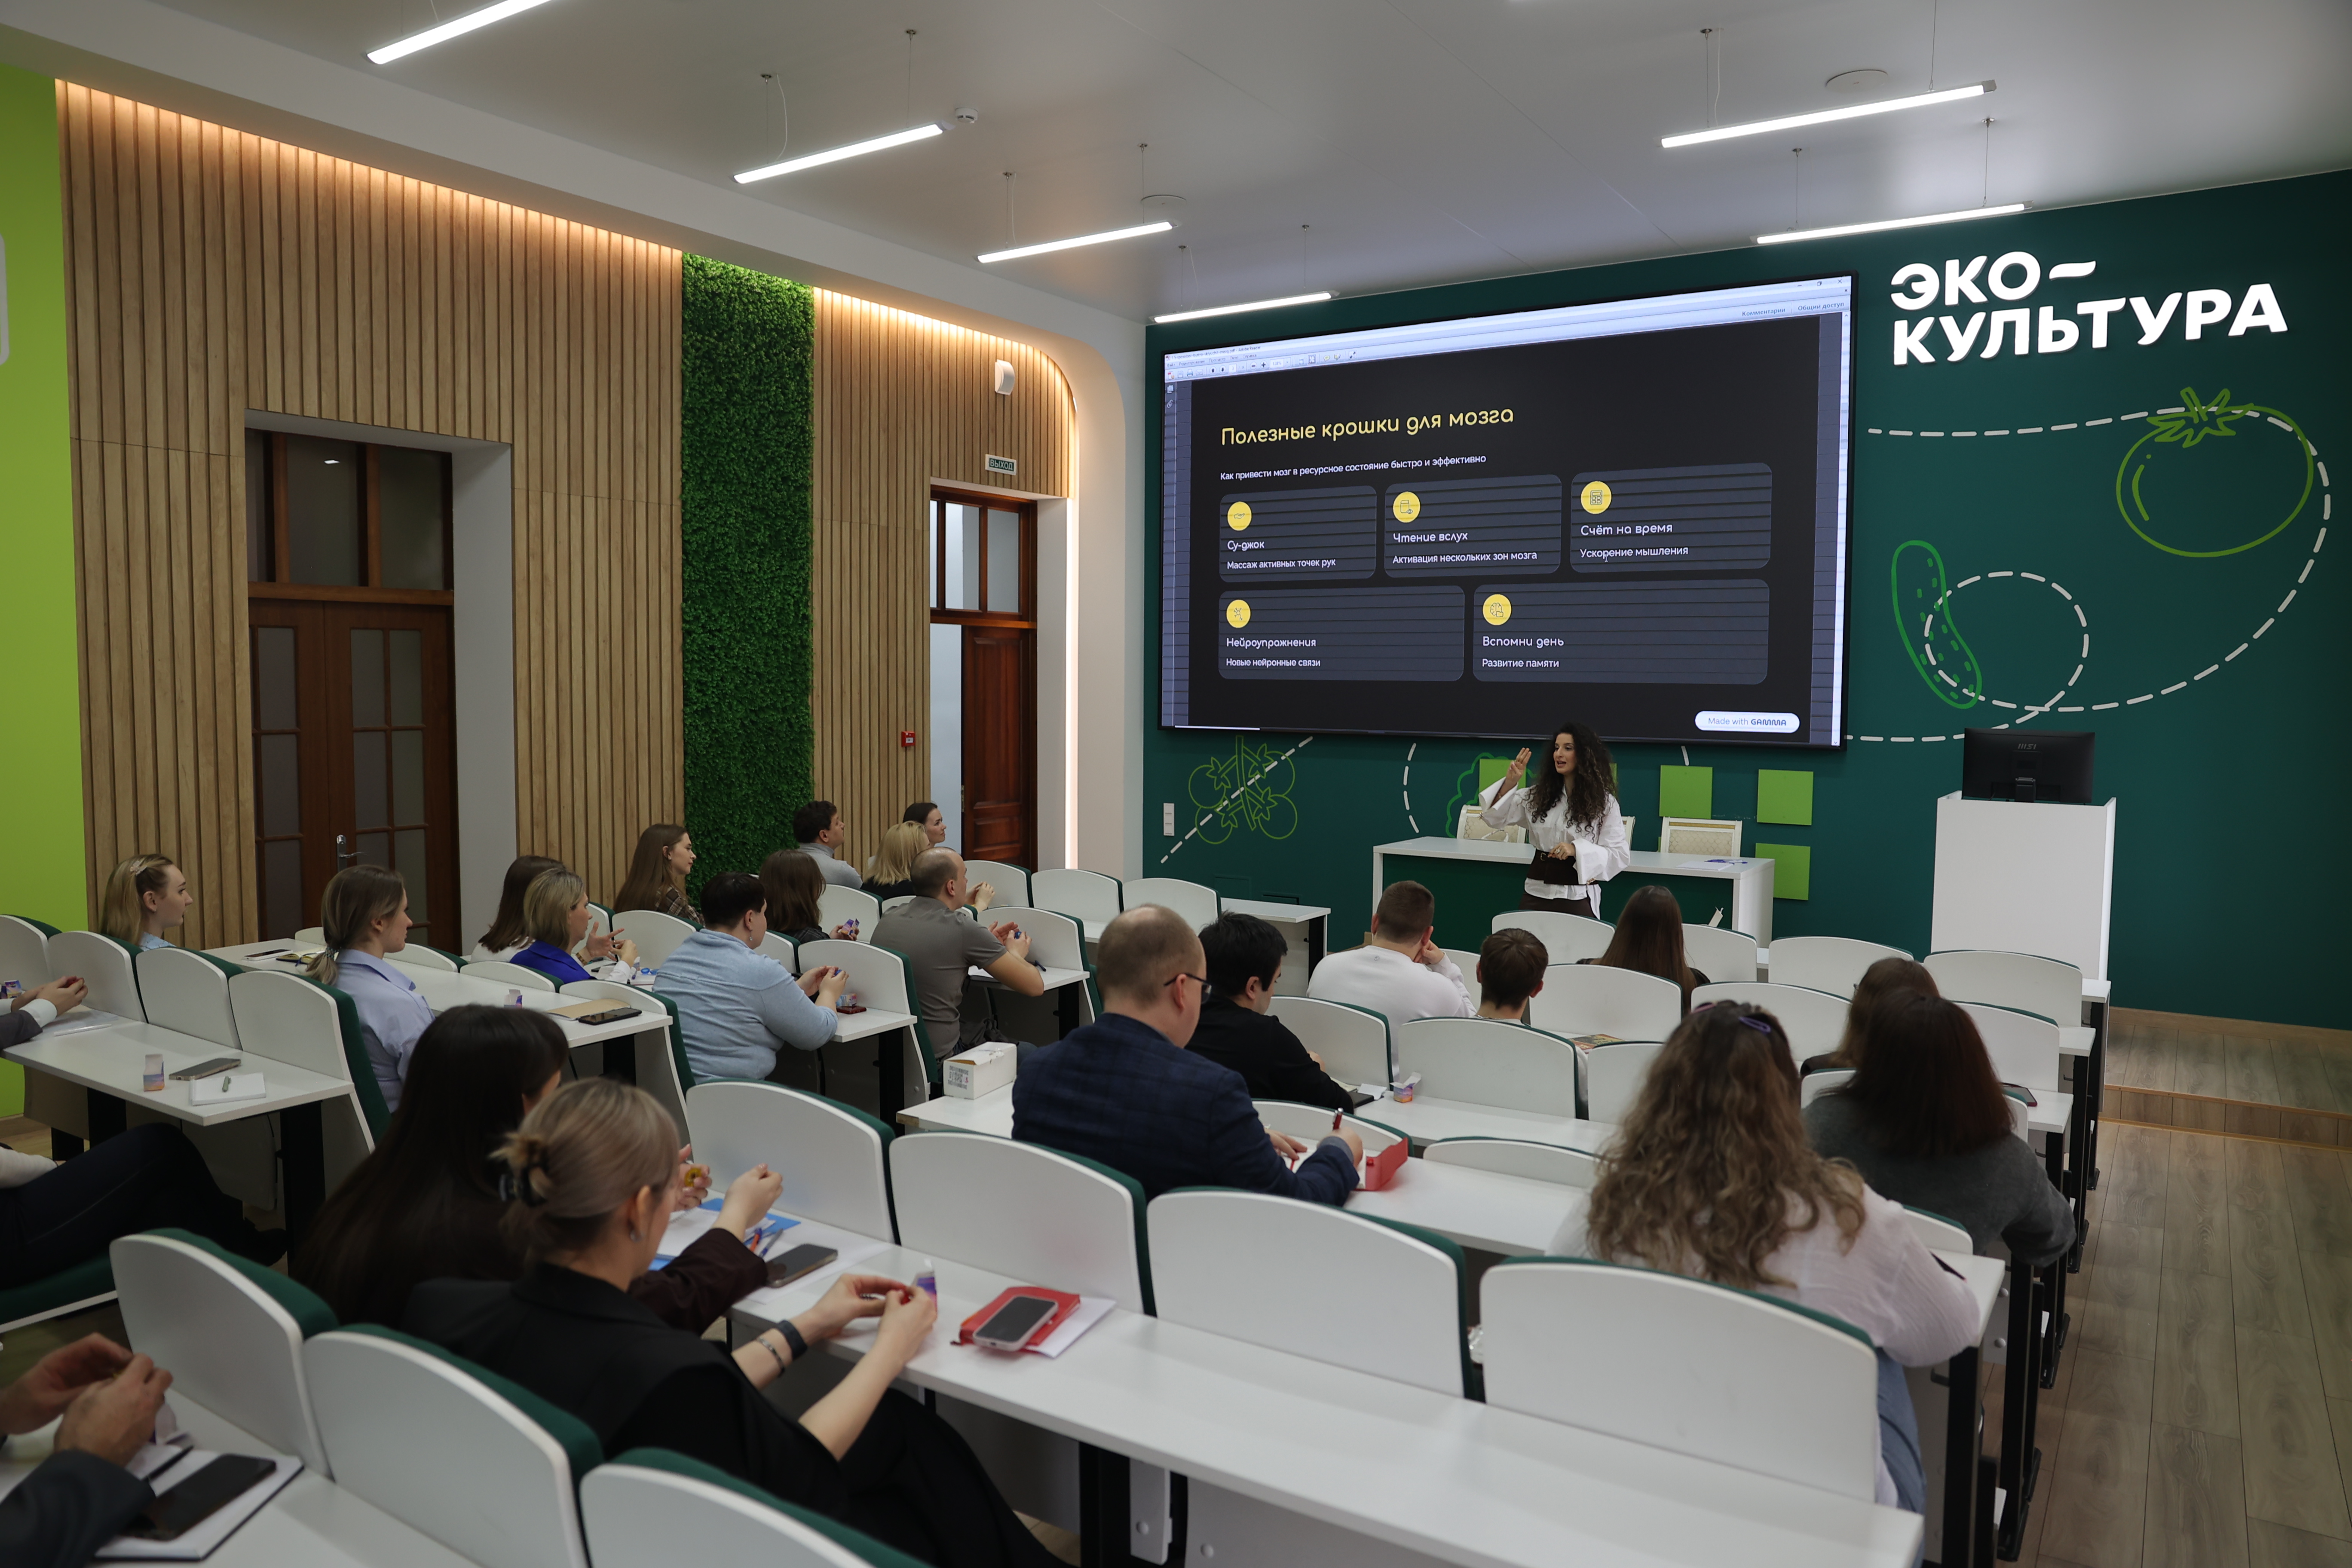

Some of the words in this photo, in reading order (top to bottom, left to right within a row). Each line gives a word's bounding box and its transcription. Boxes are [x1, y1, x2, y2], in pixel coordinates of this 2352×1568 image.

[1742, 307, 1785, 317] Комментарии
[1822, 302, 1844, 311] доступ
[1893, 283, 2288, 366] КУЛЬТУРА
[1222, 425, 1316, 445] Полезные
[1322, 418, 1399, 441] крошки
[1407, 414, 1441, 435] для
[1449, 408, 1513, 427] мозга
[990, 459, 1013, 471] ВЫХОД
[1235, 469, 1271, 481] привести
[1274, 469, 1291, 477] мозг
[1299, 466, 1344, 476] ресурсное
[1345, 462, 1389, 472] состояние
[1391, 459, 1423, 469] быстро
[1432, 455, 1487, 467] эффективно
[1580, 524, 1613, 536] Счёт
[1617, 525, 1632, 534] на
[1635, 524, 1673, 536] время
[1393, 533, 1436, 543] Чтение
[1439, 532, 1468, 542] вслух
[1227, 540, 1265, 551] Су-джок
[1393, 555, 1438, 564] Активация
[1440, 554, 1491, 563] нескольких
[1511, 552, 1537, 560] мозга
[1580, 548, 1633, 559] Ускорение
[1635, 546, 1689, 557] мышления
[1227, 560, 1258, 569] Массаж
[1259, 560, 1296, 568] активных
[1321, 558, 1336, 568] рук
[1226, 637, 1316, 649] Нейроупражнения
[1482, 636, 1532, 646] Вспомни
[1536, 637, 1565, 649] день
[1226, 658, 1251, 667] Новые
[1253, 658, 1297, 668] нейронные
[1482, 658, 1524, 668] Развитие
[1526, 659, 1559, 668] памяти
